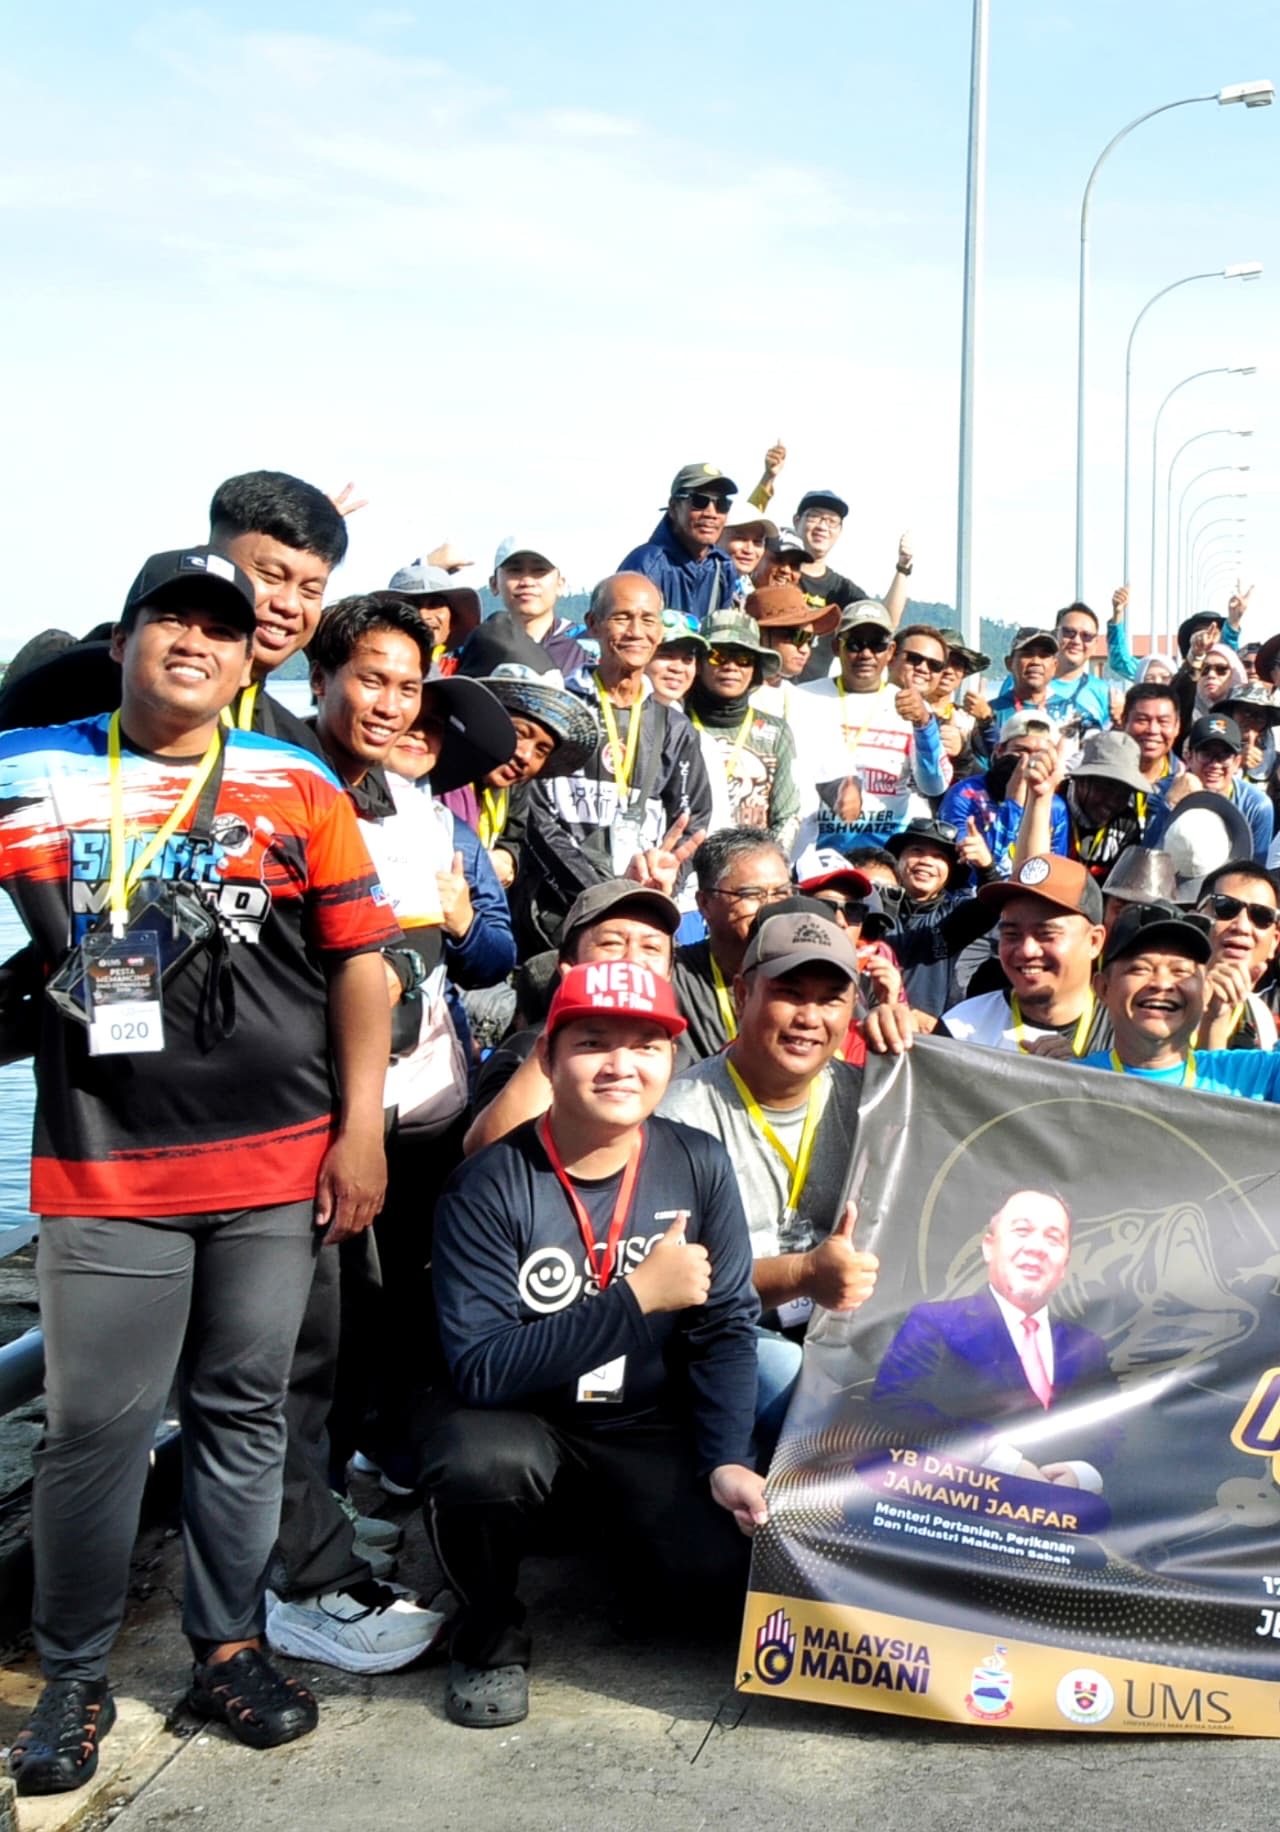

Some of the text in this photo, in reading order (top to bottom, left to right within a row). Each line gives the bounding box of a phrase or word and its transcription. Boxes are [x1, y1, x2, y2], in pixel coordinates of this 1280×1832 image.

[110, 1021, 149, 1041] 020
[889, 1448, 1002, 1492] YB DATUK
[883, 1471, 1080, 1530] JAMAWI JAAFAR
[872, 1516, 1071, 1566] Dan Industri Makanan Sabah
[875, 1502, 1076, 1555] Menteri Pertanian, Perikanan
[803, 1625, 930, 1666] MALAYSIA
[800, 1648, 931, 1695] MADANI
[1123, 1678, 1232, 1724] UMS
